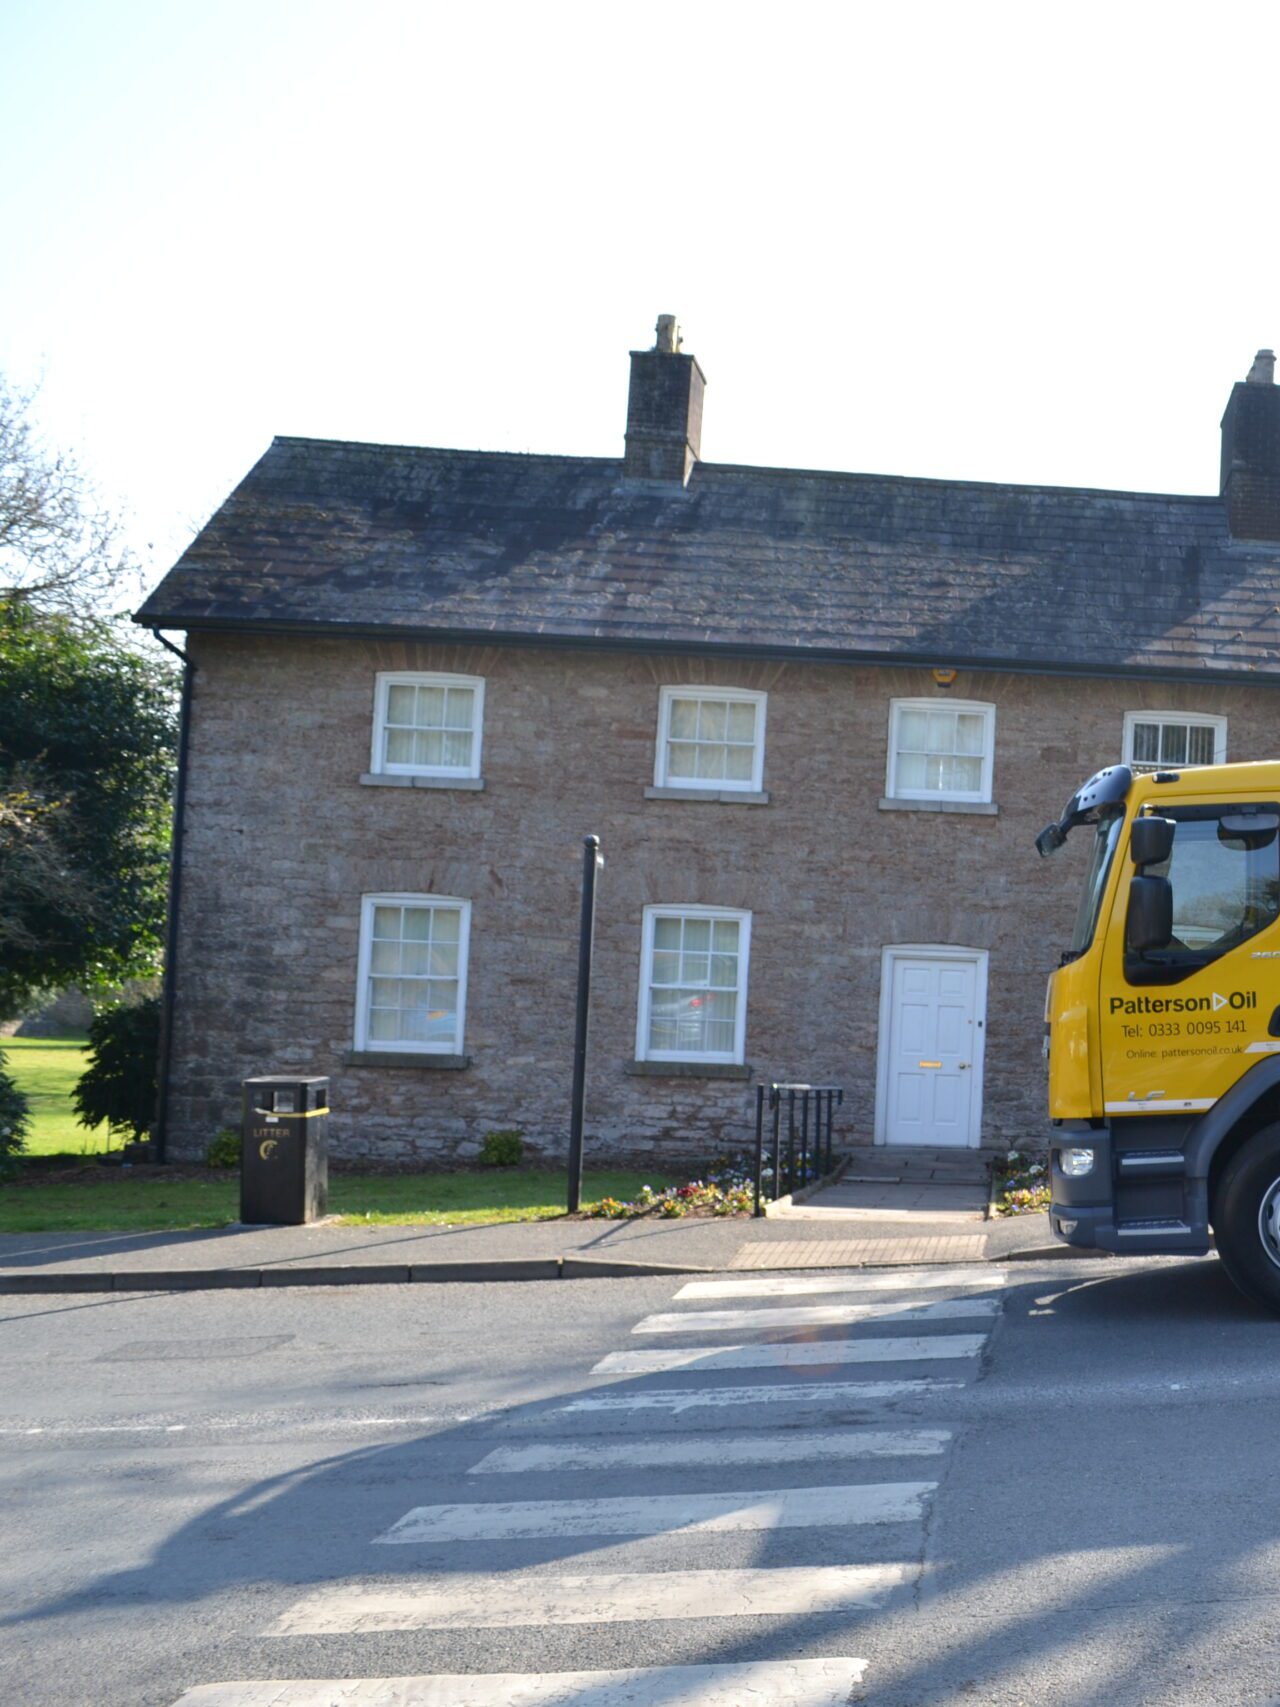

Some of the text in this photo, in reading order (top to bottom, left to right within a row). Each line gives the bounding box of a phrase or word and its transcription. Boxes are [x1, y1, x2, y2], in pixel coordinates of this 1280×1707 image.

[1109, 991, 1257, 1015] Patterson Oil
[1121, 1019, 1247, 1038] Tel: 0333 0095 141
[1161, 1044, 1243, 1060] pattersonoil.co.uk
[253, 1128, 290, 1138] LITTER
